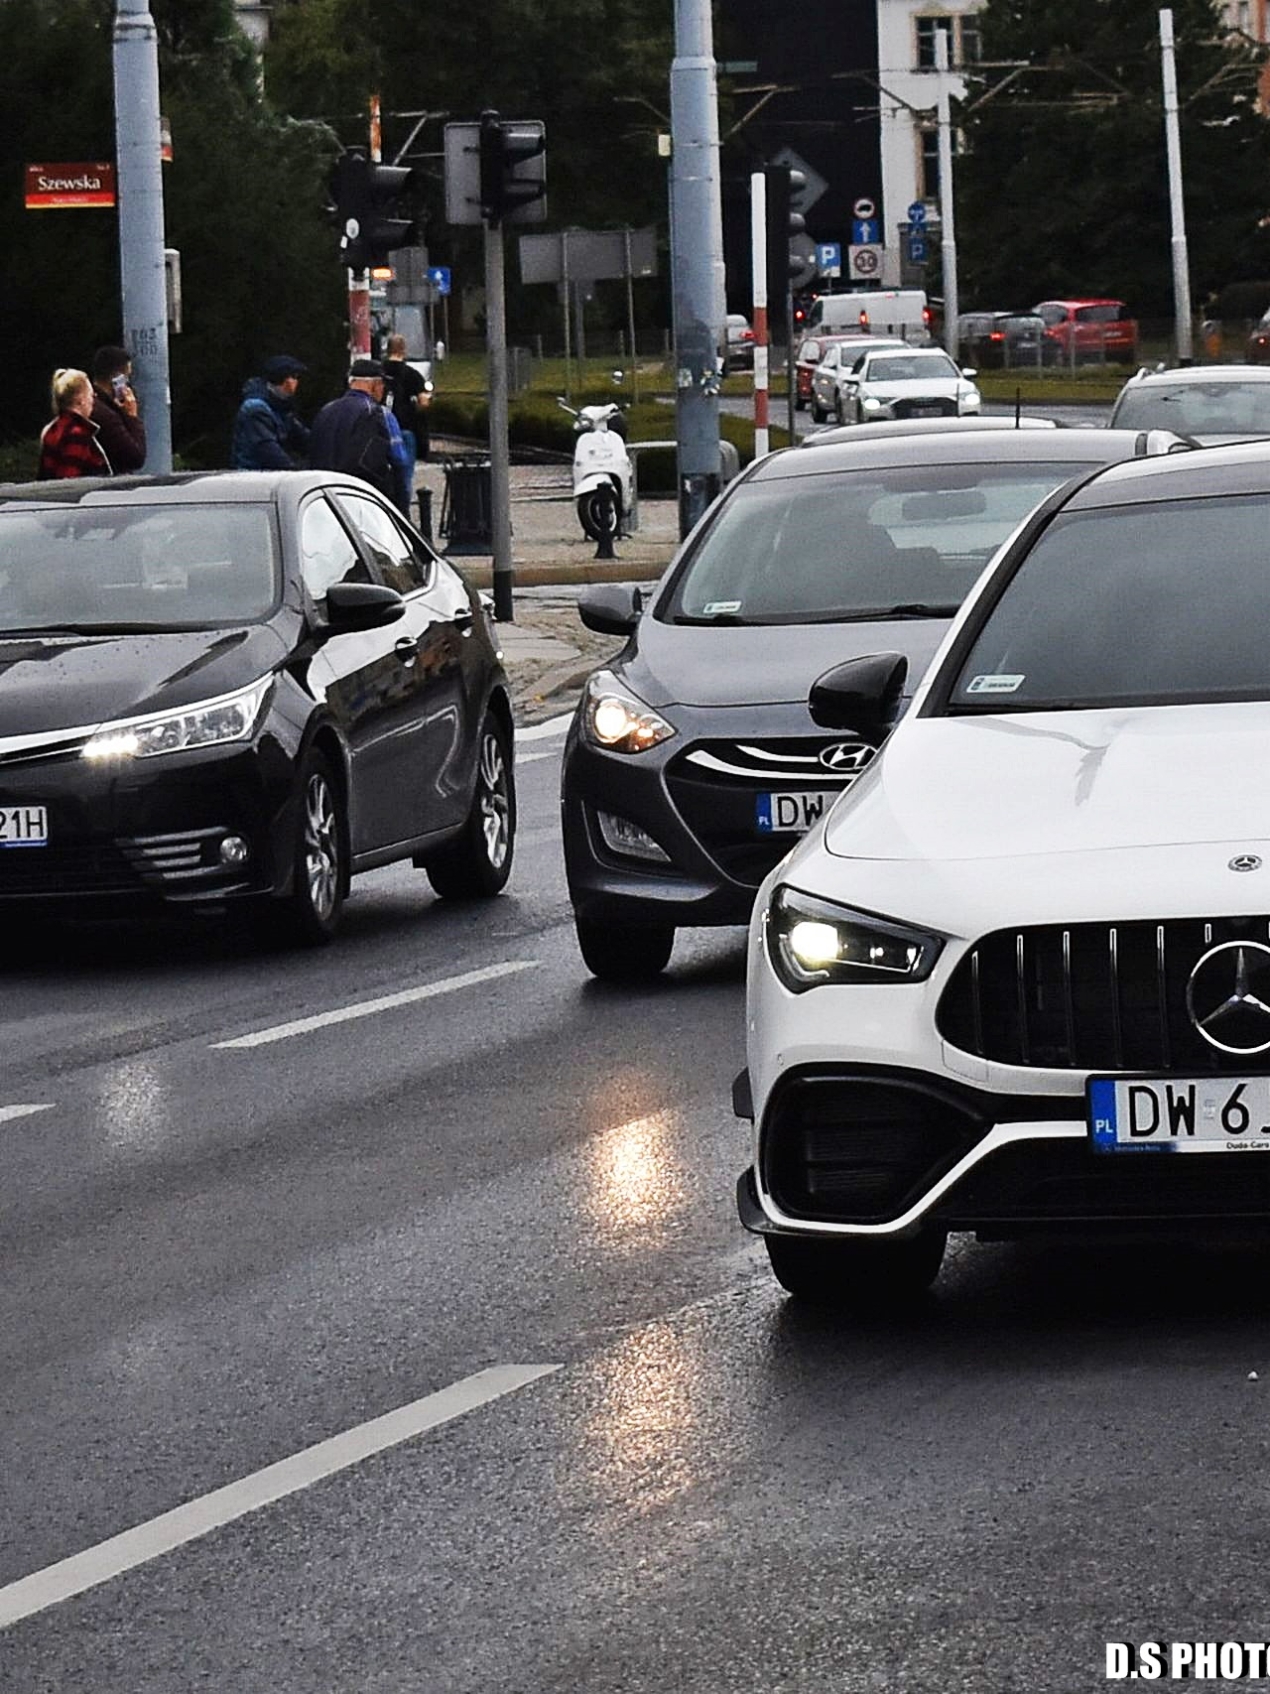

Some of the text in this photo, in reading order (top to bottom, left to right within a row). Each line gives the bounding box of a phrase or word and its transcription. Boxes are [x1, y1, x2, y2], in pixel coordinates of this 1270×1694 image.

[38, 175, 101, 191] Szewska
[822, 246, 835, 264] P
[777, 794, 823, 827] DW
[1128, 1083, 1196, 1137] DW
[1095, 1119, 1113, 1134] PL
